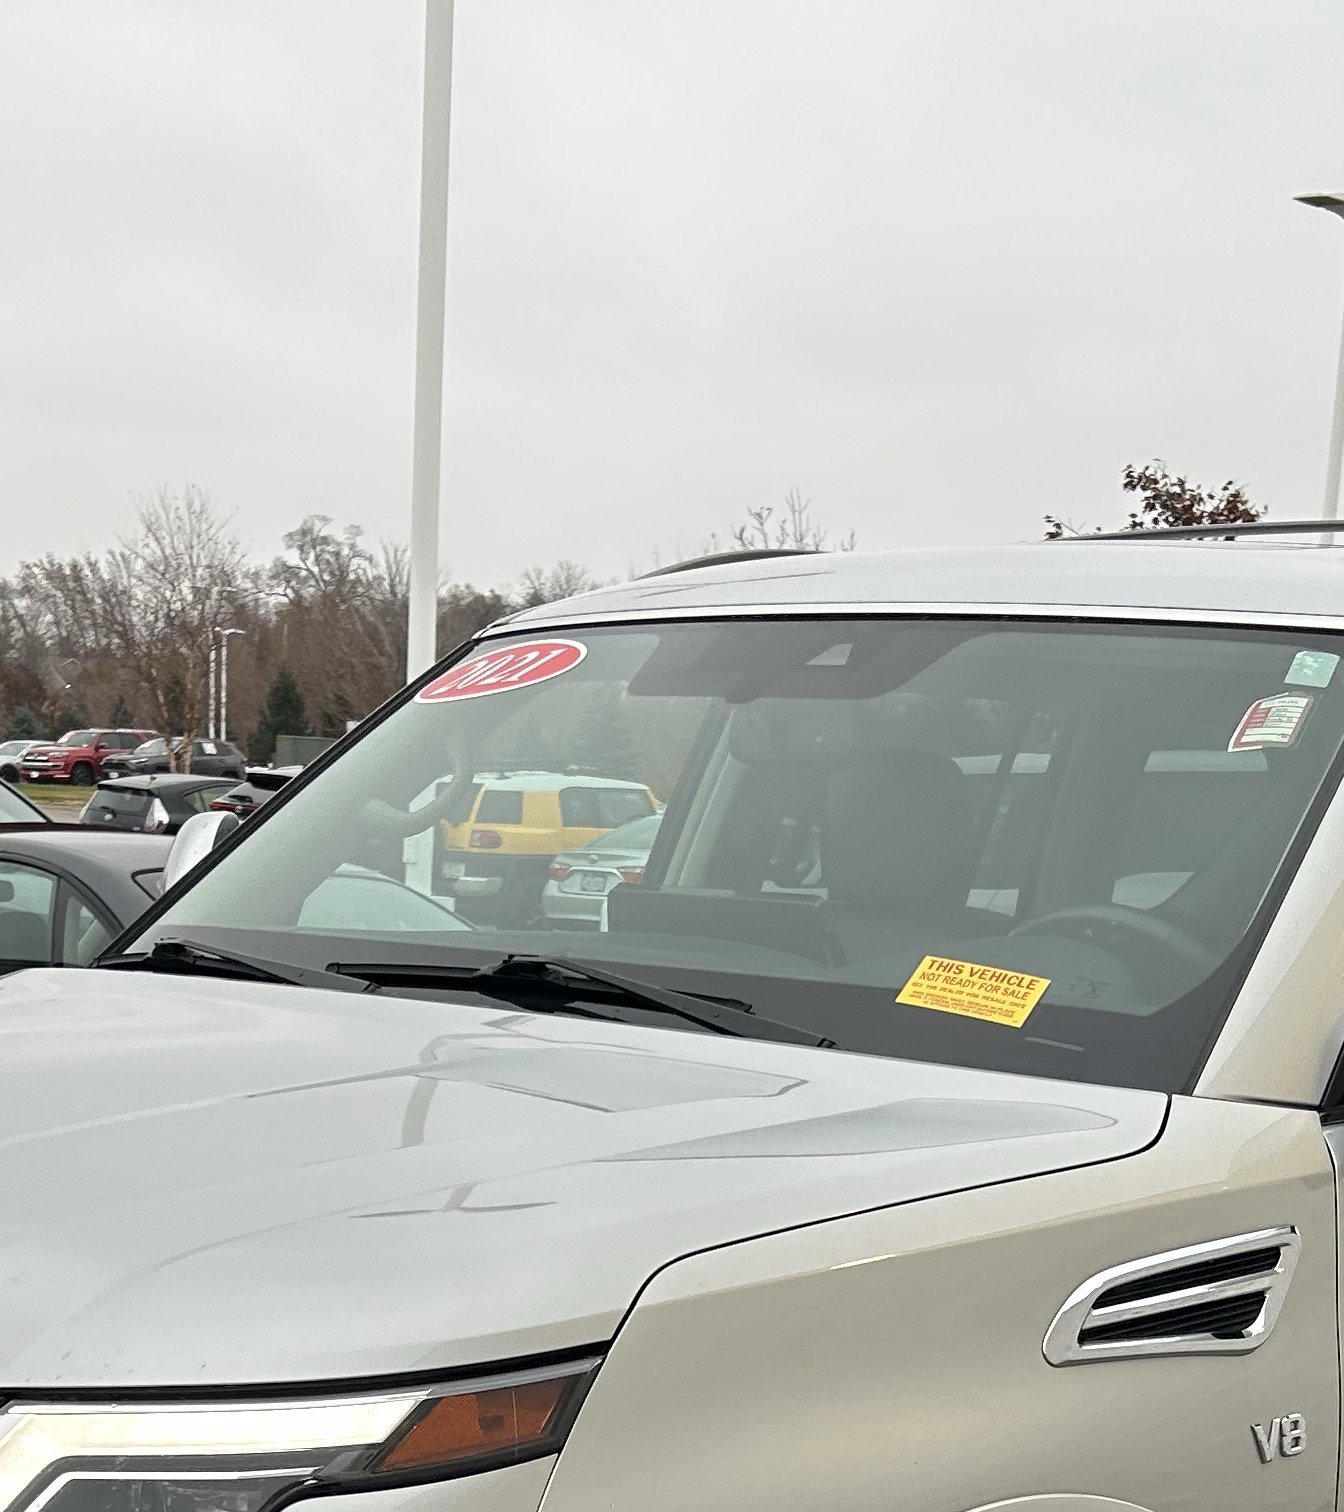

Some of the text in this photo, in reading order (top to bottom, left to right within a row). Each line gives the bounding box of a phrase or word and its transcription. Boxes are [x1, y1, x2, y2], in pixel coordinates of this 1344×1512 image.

[428, 648, 569, 696] 2021
[918, 971, 1031, 1001] NOT READY FOR SALE
[927, 959, 1040, 990] THIS VEHICLE
[1250, 1413, 1307, 1464] V8
